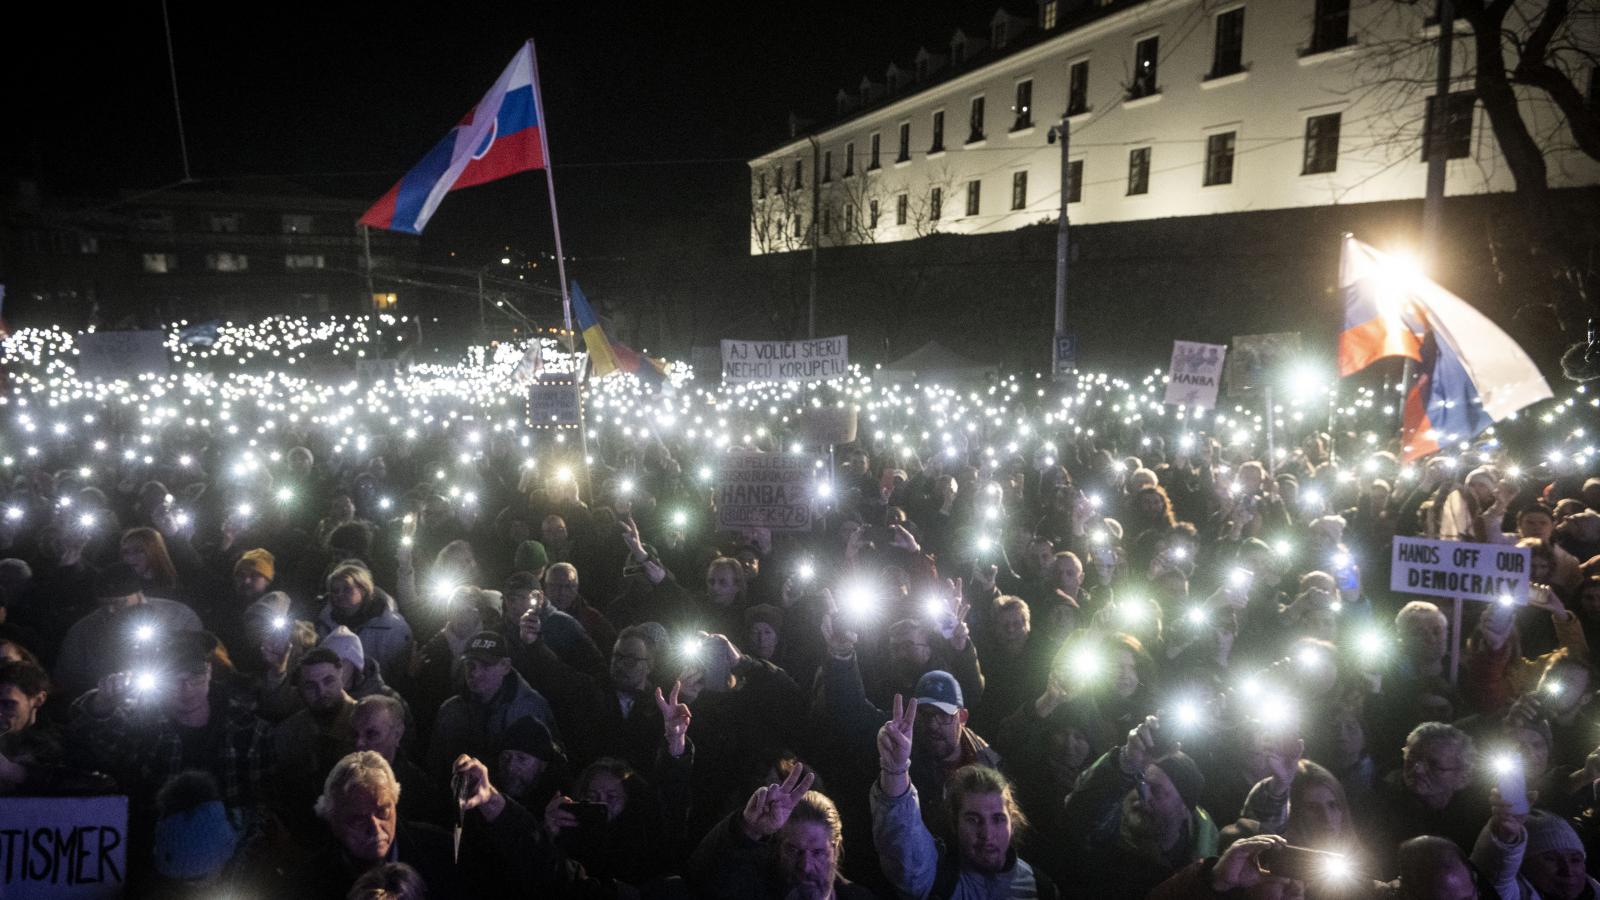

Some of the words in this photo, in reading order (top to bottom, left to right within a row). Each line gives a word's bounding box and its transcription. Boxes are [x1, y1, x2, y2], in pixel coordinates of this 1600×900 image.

[730, 343, 748, 359] AJ
[802, 340, 841, 358] SMERU
[779, 359, 845, 378] KORUPCIU
[1173, 372, 1214, 387] HANBA
[721, 484, 787, 504] HANBA
[1398, 543, 1440, 564] HANDS
[1453, 547, 1480, 569] OFF
[1496, 551, 1524, 573] OUR
[1408, 568, 1519, 595] DEMOCRACY
[0, 826, 122, 886] TISMER
